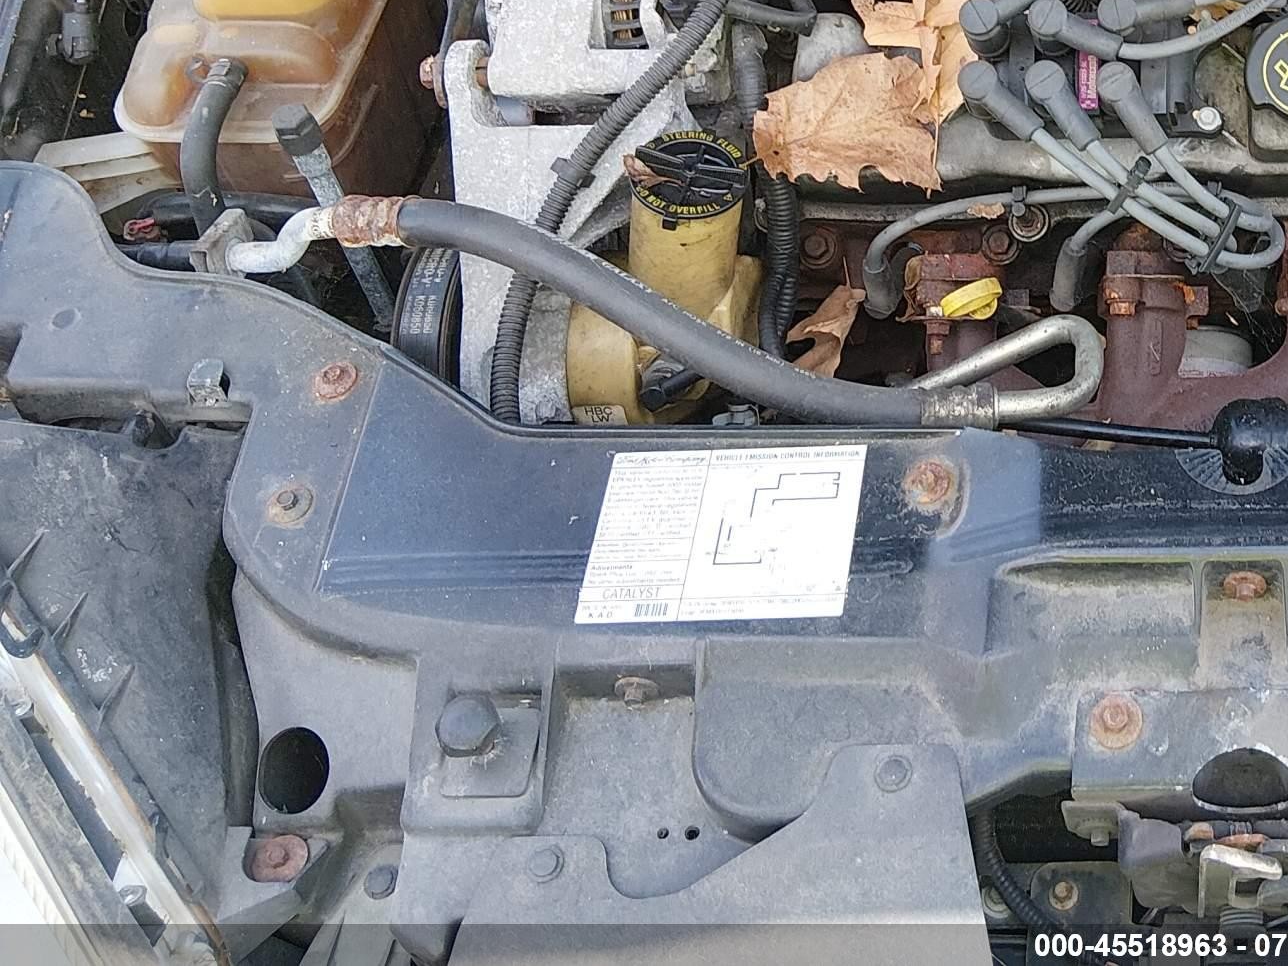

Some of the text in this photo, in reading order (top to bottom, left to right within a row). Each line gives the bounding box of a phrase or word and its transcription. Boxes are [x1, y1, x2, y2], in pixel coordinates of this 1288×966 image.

[661, 130, 742, 160] STEERING FLUID
[647, 195, 667, 209] NOT
[669, 202, 721, 215] OVERFILL
[409, 295, 427, 335] K060850
[584, 406, 613, 416] HBC
[591, 415, 610, 423] LW
[715, 450, 861, 462] VEHICLE EMISSION CONTROL INFORMATION
[601, 587, 662, 600] CATALYST
